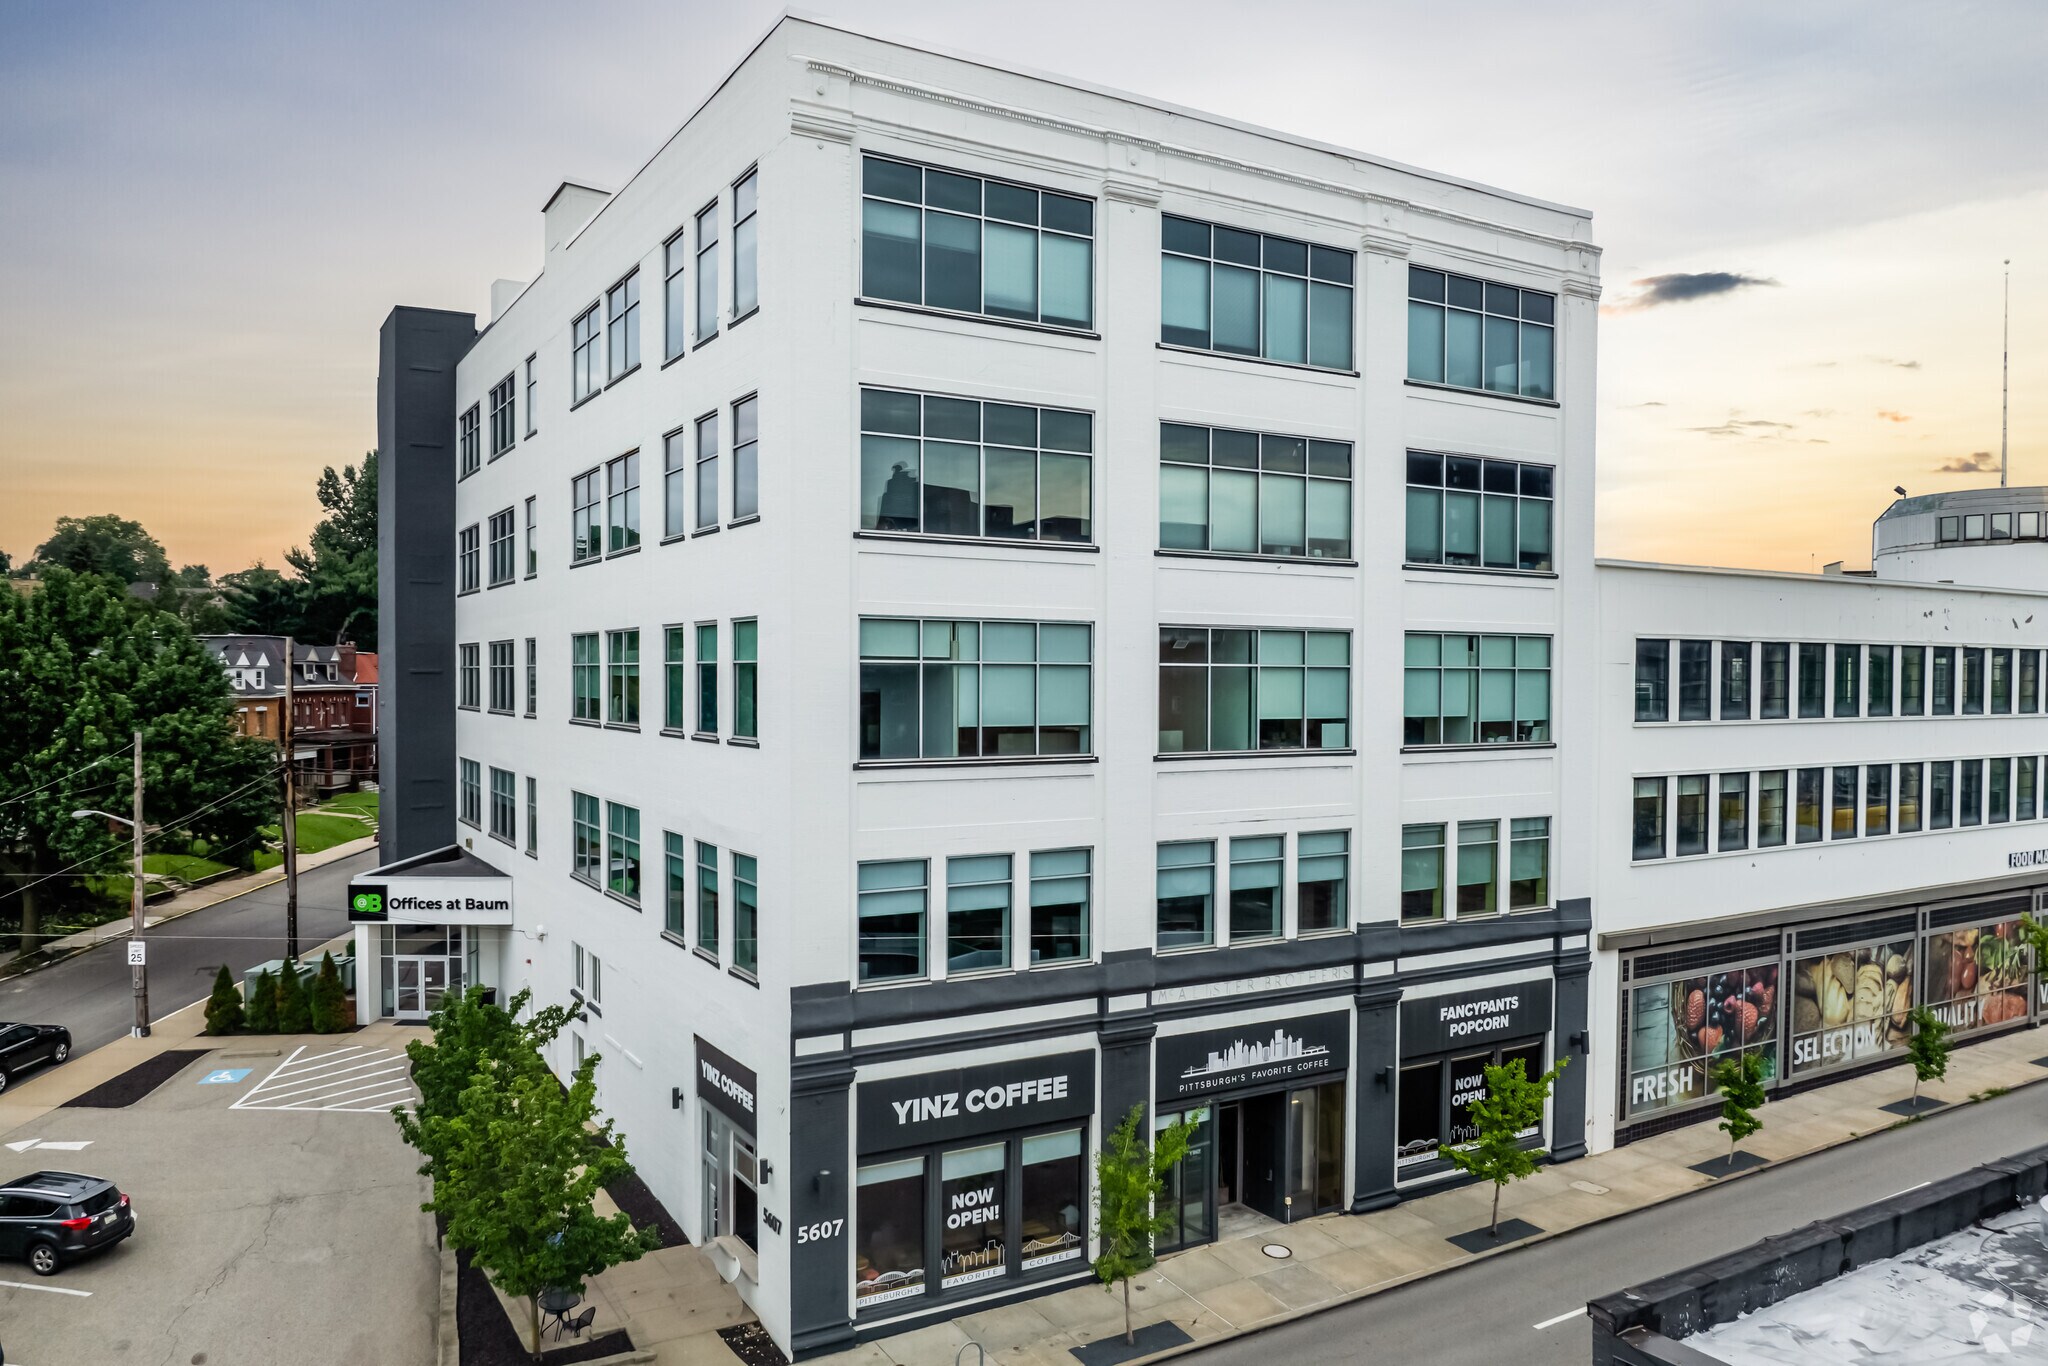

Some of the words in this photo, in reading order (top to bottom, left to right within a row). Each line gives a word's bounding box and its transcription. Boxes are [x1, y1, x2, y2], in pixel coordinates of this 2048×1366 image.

[2011, 851, 2034, 868] FOOD
[389, 897, 442, 910] Offices
[446, 898, 461, 910] at
[465, 898, 509, 910] Baum
[130, 953, 143, 963] 25
[1440, 996, 1519, 1021] FANCYPANTS
[1449, 1014, 1509, 1037] POPCORN
[1793, 1023, 1876, 1065] SELECTION
[701, 1058, 721, 1088] YINZ
[721, 1074, 754, 1113] COFFEE
[1179, 1074, 1246, 1092] PITTSBURGH'S
[1251, 1065, 1292, 1079] FAVORITE
[1297, 1058, 1329, 1071] COFFEE
[1455, 1073, 1483, 1091] NOW
[1632, 1066, 1693, 1105] FRESH
[892, 1092, 959, 1125] YINZ
[965, 1075, 1068, 1113] COFFEE
[1451, 1088, 1486, 1107] OPEN!
[951, 1186, 994, 1210] NOW
[763, 1206, 782, 1236] 5607
[946, 1204, 1000, 1229] OPEN!
[797, 1218, 844, 1244] 5607
[859, 1286, 920, 1306] PITTSBURGH'S
[946, 1268, 999, 1286] FAVORITE
[1029, 1251, 1072, 1267] COFFEE
